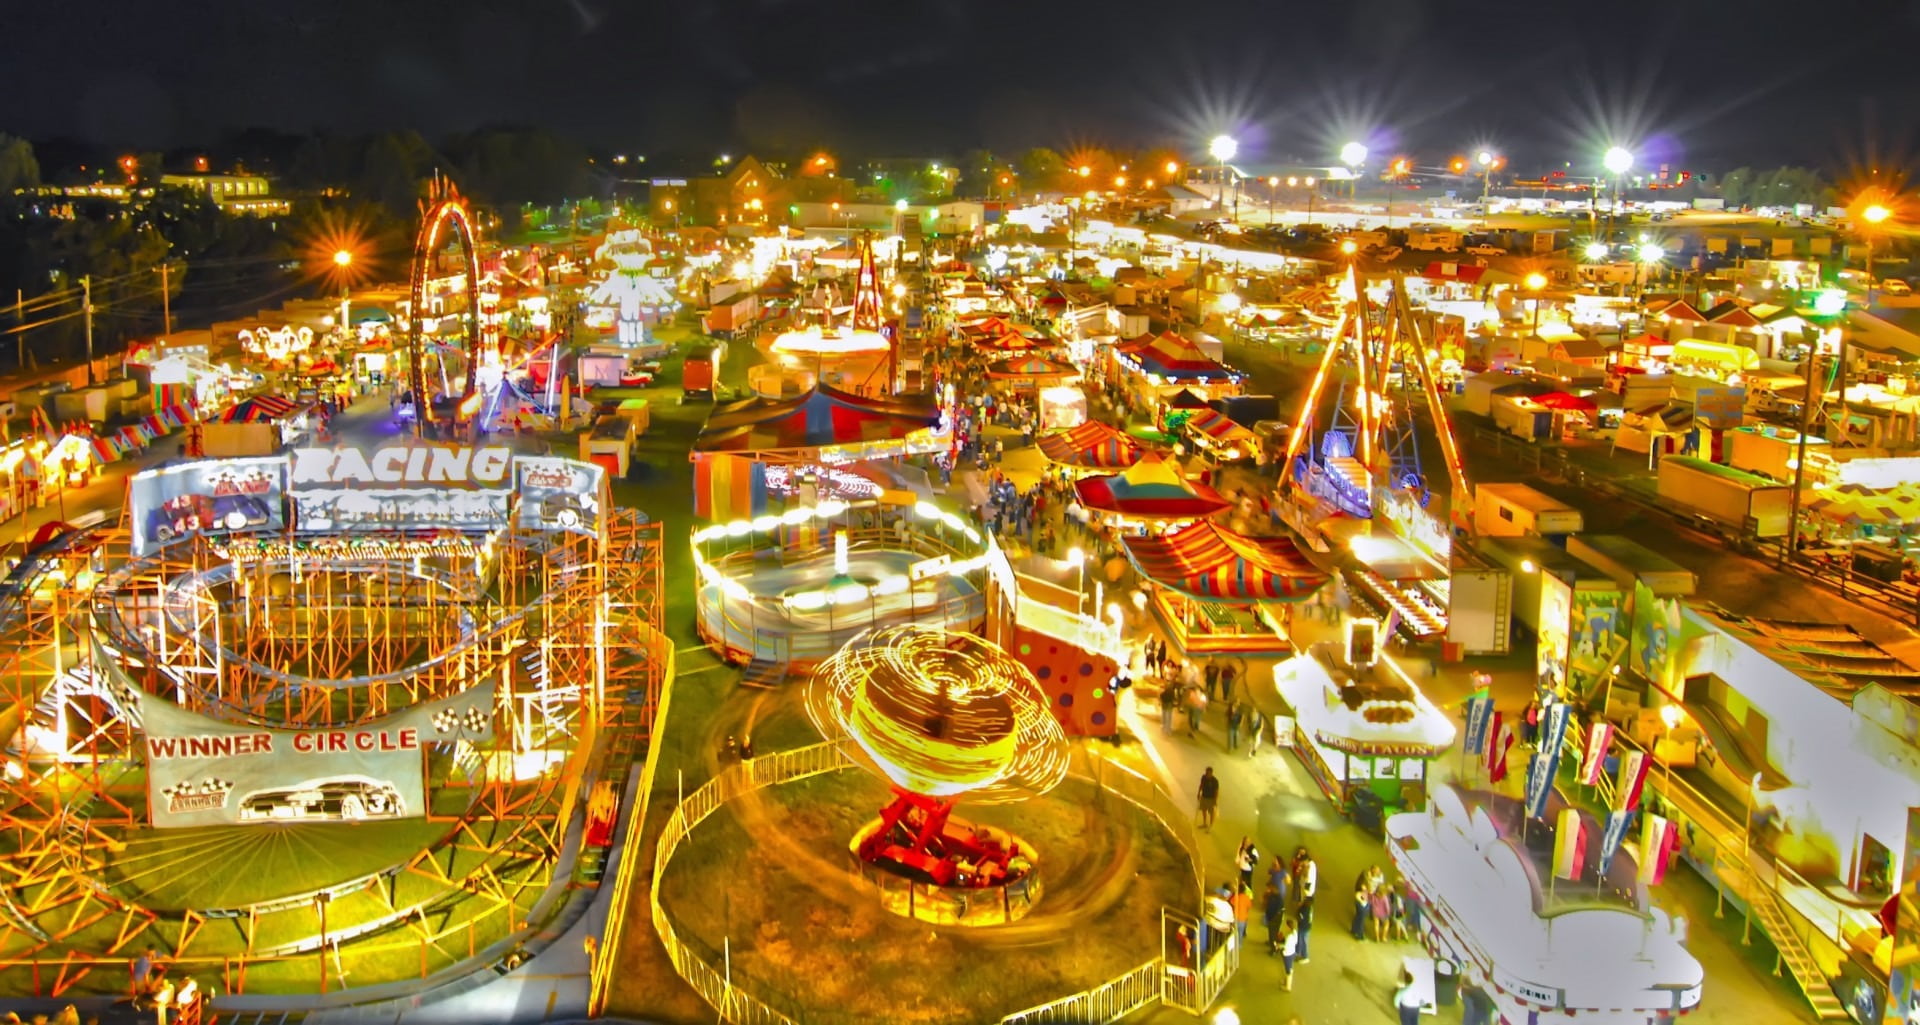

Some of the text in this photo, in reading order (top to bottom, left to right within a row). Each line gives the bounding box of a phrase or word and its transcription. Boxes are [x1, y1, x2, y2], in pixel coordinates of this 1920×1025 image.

[293, 447, 510, 483] RACING
[172, 496, 191, 509] 43
[175, 515, 199, 532] 43
[150, 729, 418, 759] WINNER CIRCLE
[371, 794, 386, 813] 3
